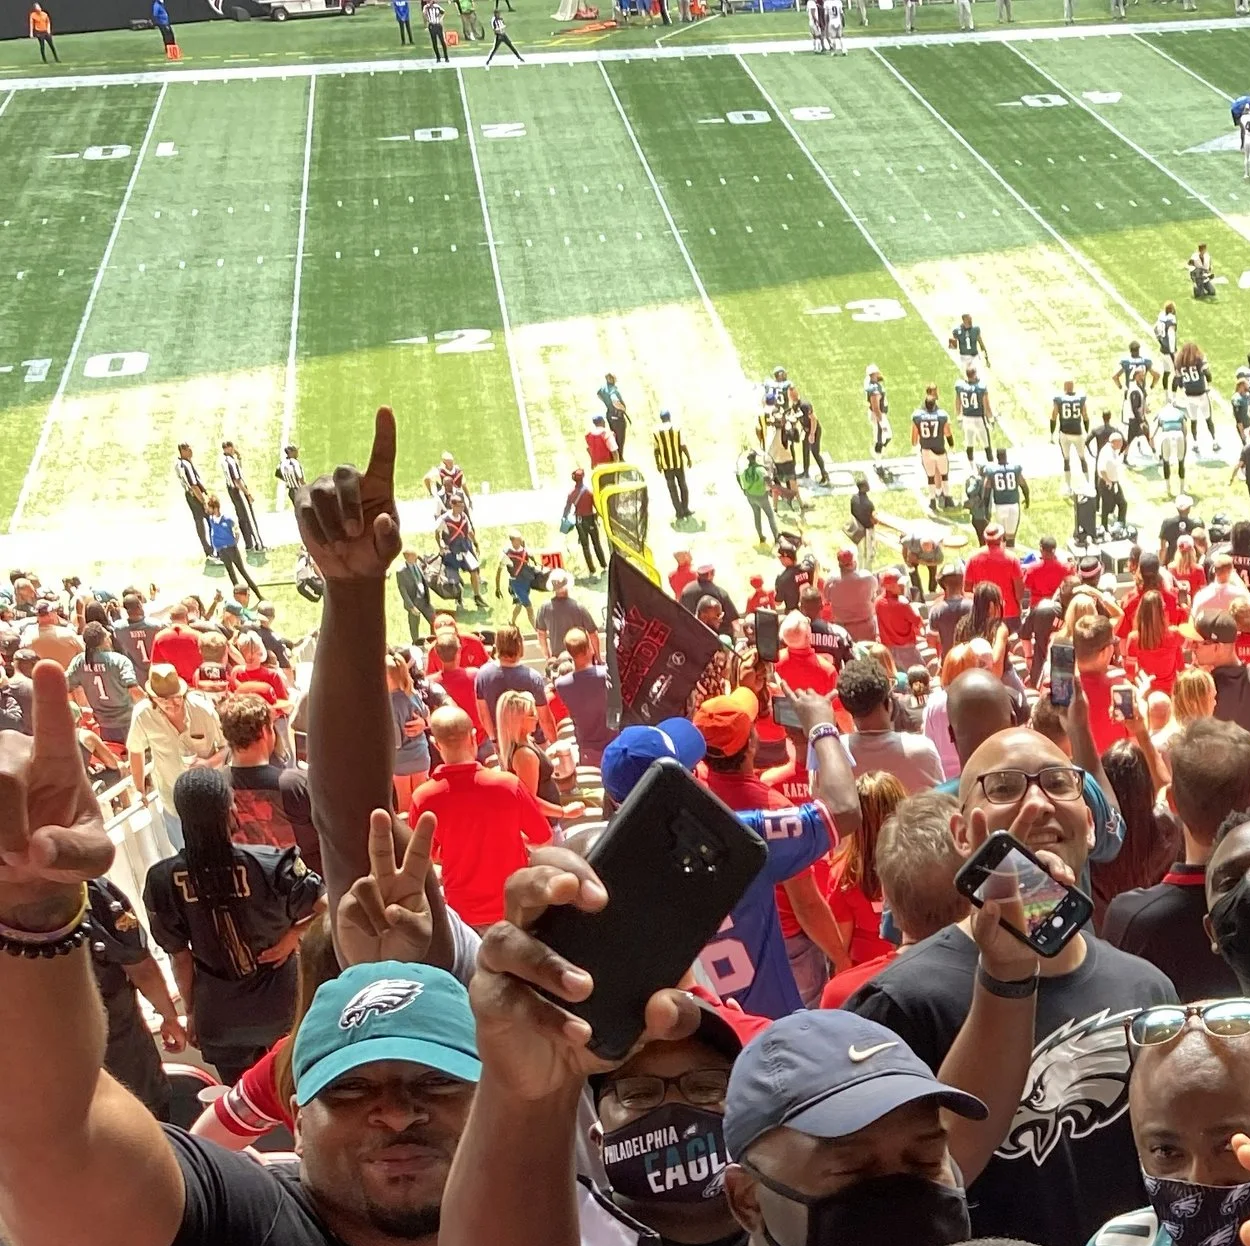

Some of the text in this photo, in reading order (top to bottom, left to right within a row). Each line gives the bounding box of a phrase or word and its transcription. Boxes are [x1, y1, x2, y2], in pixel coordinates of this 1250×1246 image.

[1181, 365, 1200, 384] 56
[959, 391, 979, 410] 64
[1061, 402, 1081, 420] 65
[919, 420, 940, 438] 67
[993, 471, 1017, 491] 68
[136, 639, 151, 663] 1
[93, 675, 110, 701] 1
[604, 1125, 679, 1165] PHILADELPHIA
